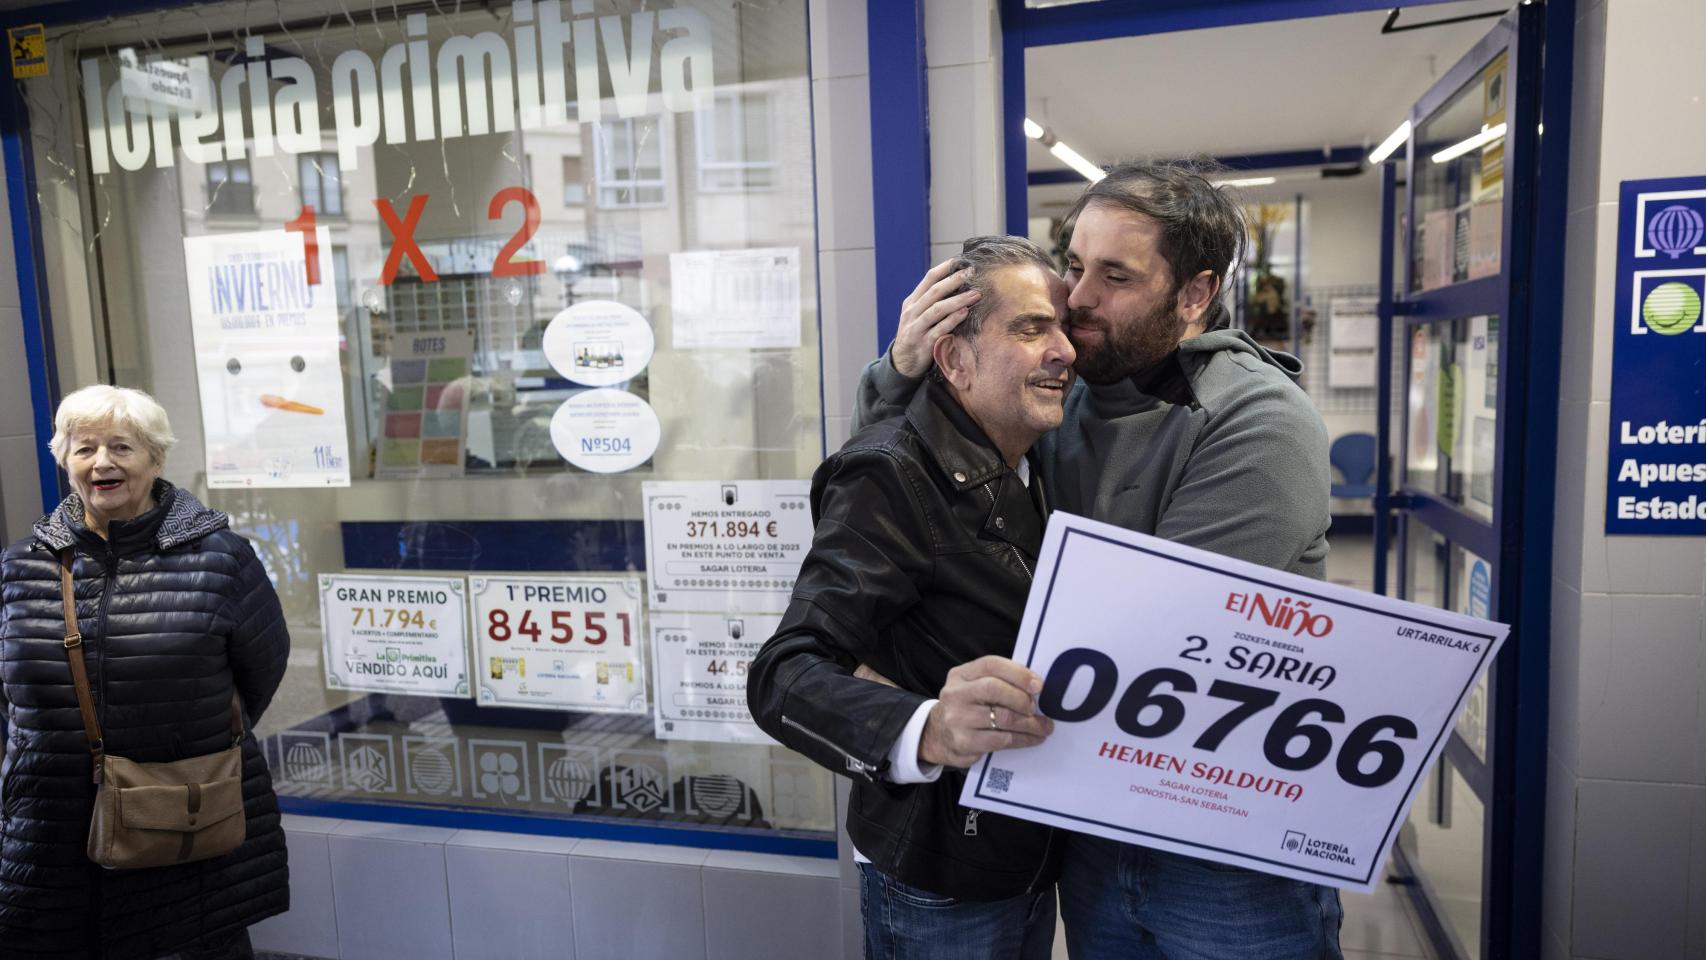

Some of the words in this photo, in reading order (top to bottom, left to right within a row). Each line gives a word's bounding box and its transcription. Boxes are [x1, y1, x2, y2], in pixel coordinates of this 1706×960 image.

[81, 35, 322, 175] loteria
[331, 0, 714, 171] primitiva
[284, 205, 321, 285] 1
[372, 194, 439, 286] X
[487, 187, 547, 277] 2
[208, 260, 314, 314] INVIERNO
[581, 437, 631, 453] Nº504
[721, 510, 772, 518] ENTREGADO
[687, 521, 760, 538] 371.894
[766, 521, 778, 538] €
[667, 543, 678, 551] EN
[679, 543, 714, 551] PREMIOS
[716, 543, 722, 551] A
[723, 543, 735, 551] LO
[736, 543, 765, 551] LARGO
[767, 543, 778, 551] DE
[780, 543, 800, 551] 2023
[682, 551, 692, 559] EN
[694, 551, 713, 559] ESTE
[715, 551, 743, 559] PUNTO
[745, 551, 756, 559] DE
[758, 551, 785, 559] VENTA
[700, 565, 729, 573] SAGAR
[731, 565, 768, 573] LOTERIA
[337, 587, 381, 602] GRAN
[387, 589, 447, 605] PREMIO
[524, 585, 607, 603] PREMIO
[352, 607, 425, 629] 71.794
[429, 619, 437, 630] €
[1246, 592, 1333, 638] Niño
[488, 608, 632, 647] 84551
[698, 641, 726, 649] HEMOS
[1233, 631, 1271, 647] ZOZKETA
[1271, 639, 1304, 654] BEREZIA
[1396, 626, 1472, 652] URTARRILAK
[1472, 643, 1481, 653] 6
[376, 652, 386, 660] La
[401, 653, 438, 663] Primitiva
[1179, 635, 1212, 664] 2.
[1224, 645, 1336, 691] SARIA
[345, 661, 407, 677] VENDIDO
[412, 663, 448, 679] AQUÍ
[706, 697, 735, 705] SAGAR
[1038, 647, 1418, 788] 06766
[1098, 741, 1188, 775] HEMEN
[1190, 761, 1303, 802] SALDUTA
[1159, 779, 1190, 793] SAGAR
[1191, 786, 1228, 801] LOTERIA
[1129, 784, 1200, 807] DONOSTIA-SAN
[1200, 800, 1248, 818] SEBASTIAN
[1308, 837, 1349, 855] LOTERÍA
[1304, 847, 1356, 866] NACIONAL
